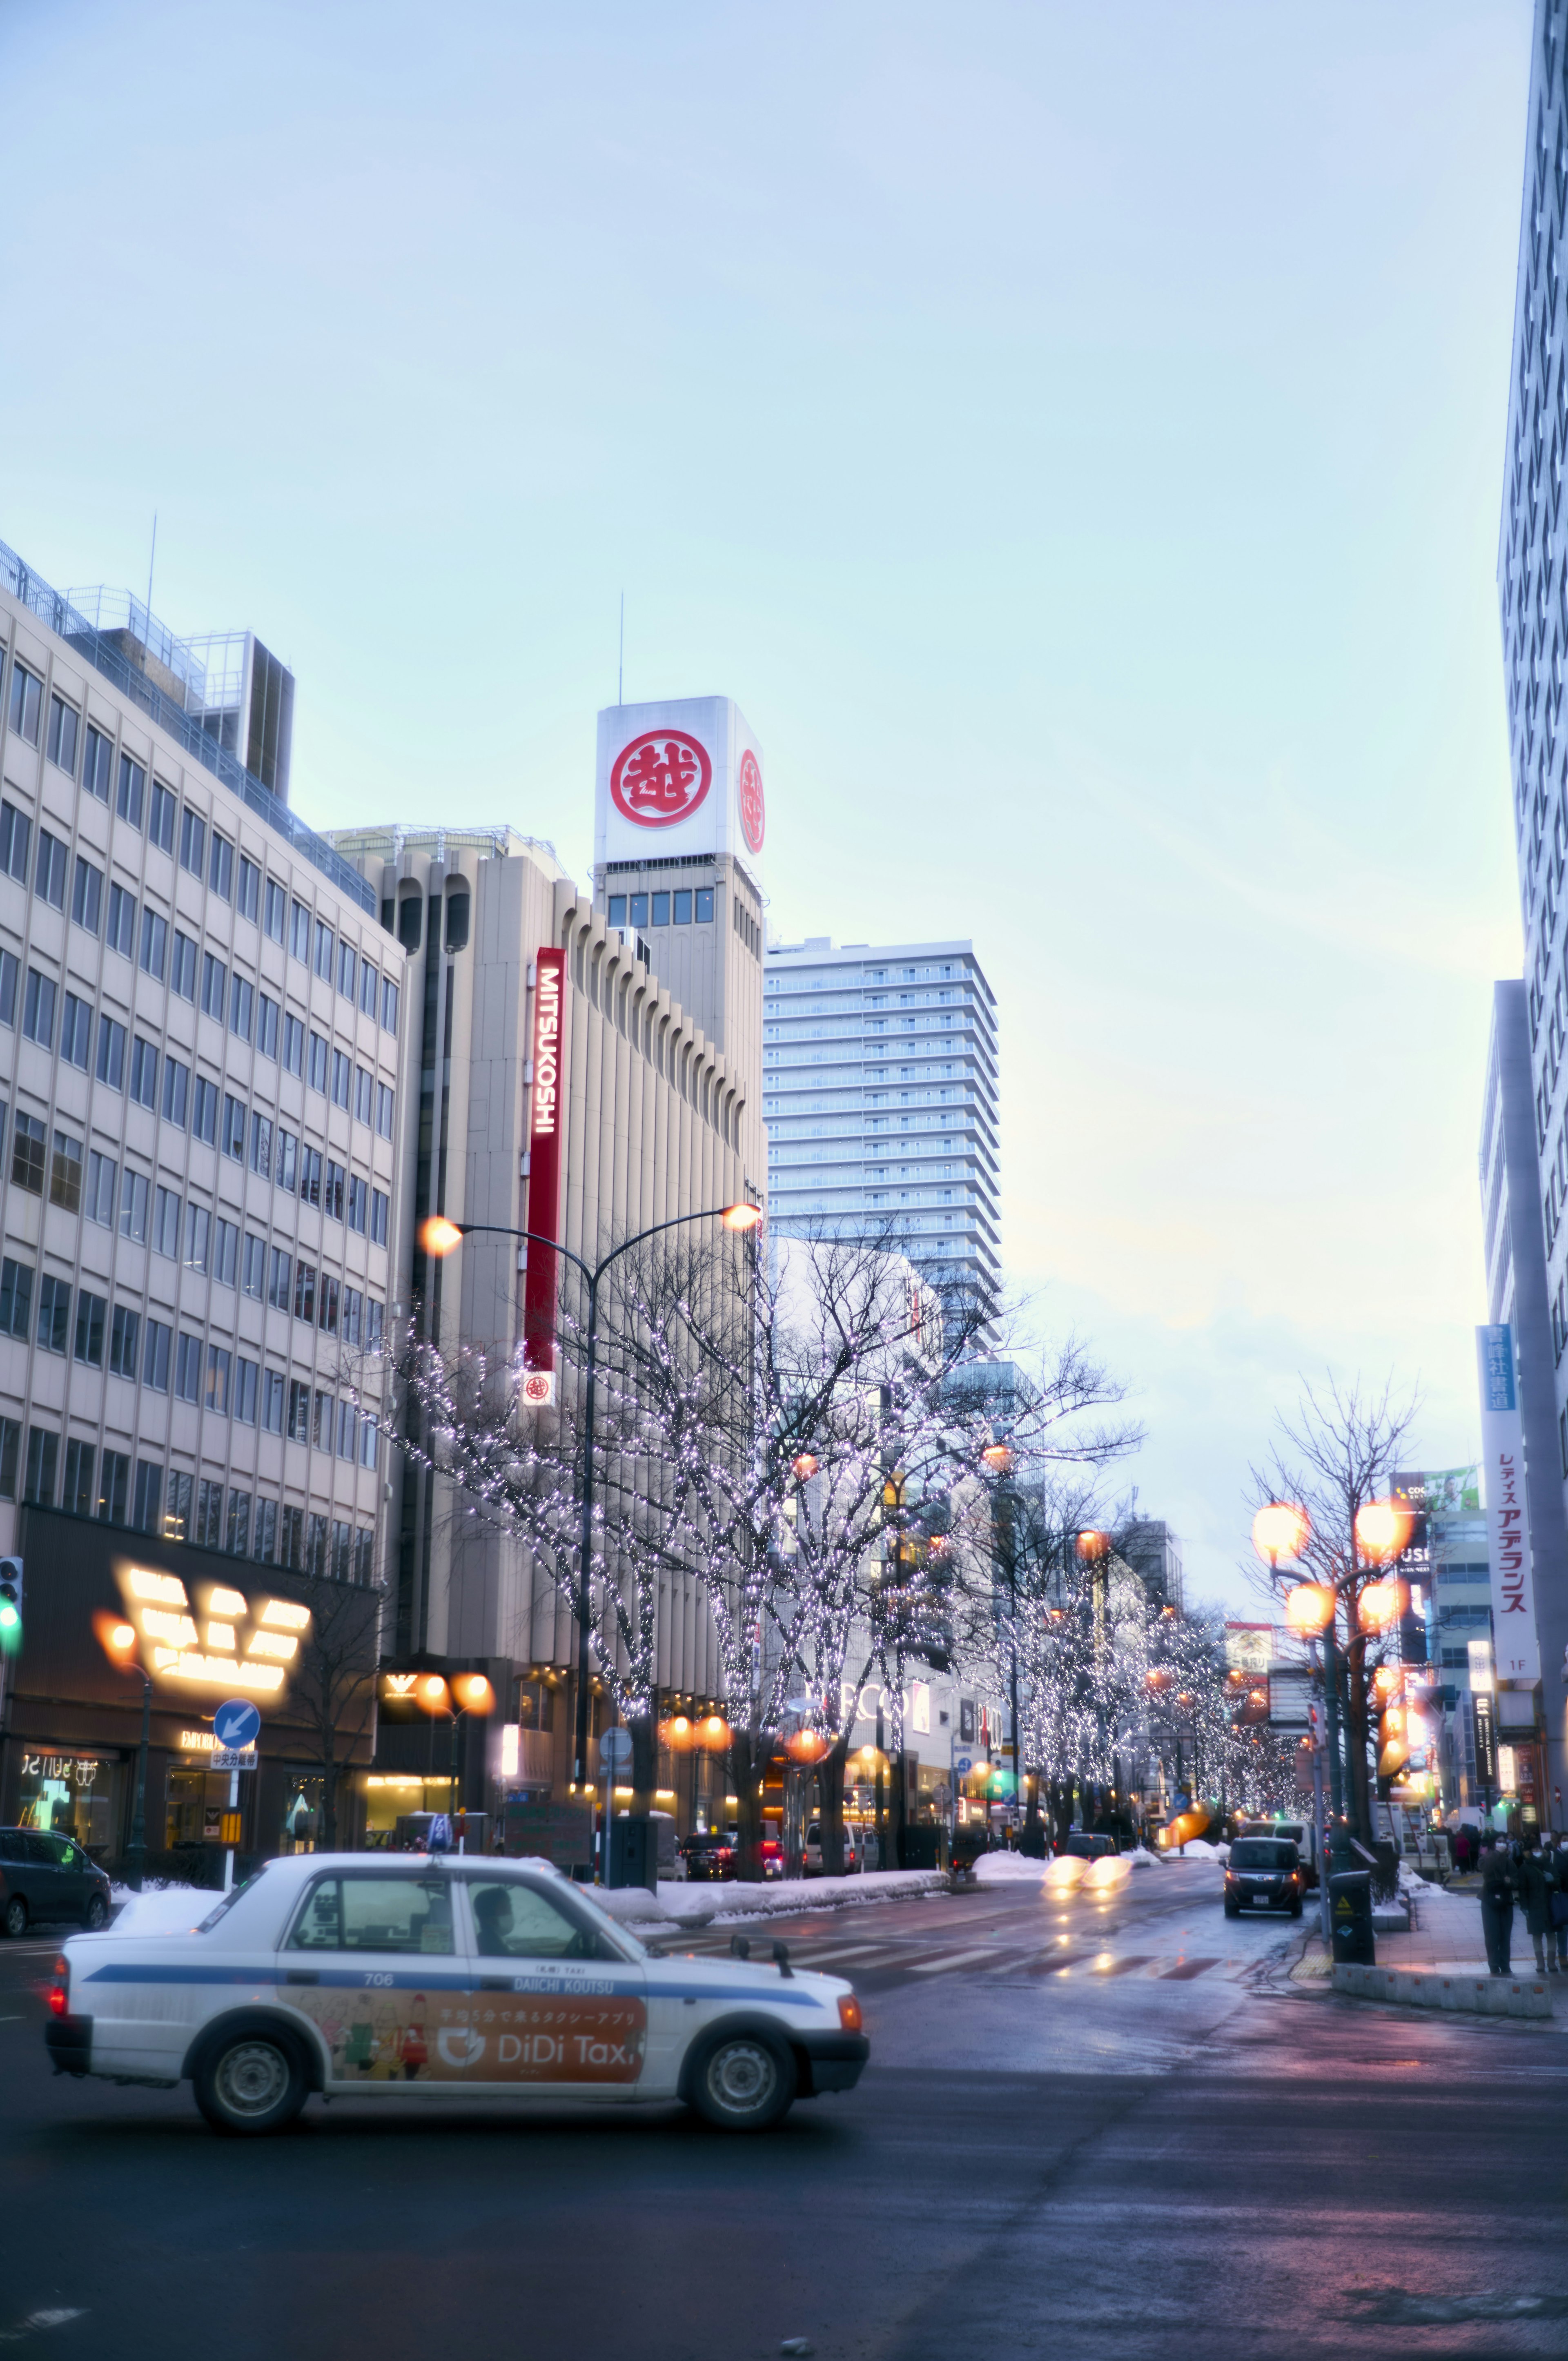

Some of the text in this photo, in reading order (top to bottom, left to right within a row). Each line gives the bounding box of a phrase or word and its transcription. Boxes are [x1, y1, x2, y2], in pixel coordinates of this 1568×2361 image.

[536, 968, 559, 1133] MITSUKOSHI
[1487, 1326, 1509, 1408] 書峰社書道
[1510, 1659, 1526, 1671] 1F
[182, 1731, 218, 1750] EMPORIO
[213, 1753, 256, 1766] 中央分離帯
[365, 1973, 394, 1986] 706
[515, 1978, 614, 1994] DAIICHI KOUTSU
[440, 2009, 635, 2025] 平均5分で来るタクシーアプリ
[498, 2034, 565, 2064] DiDi
